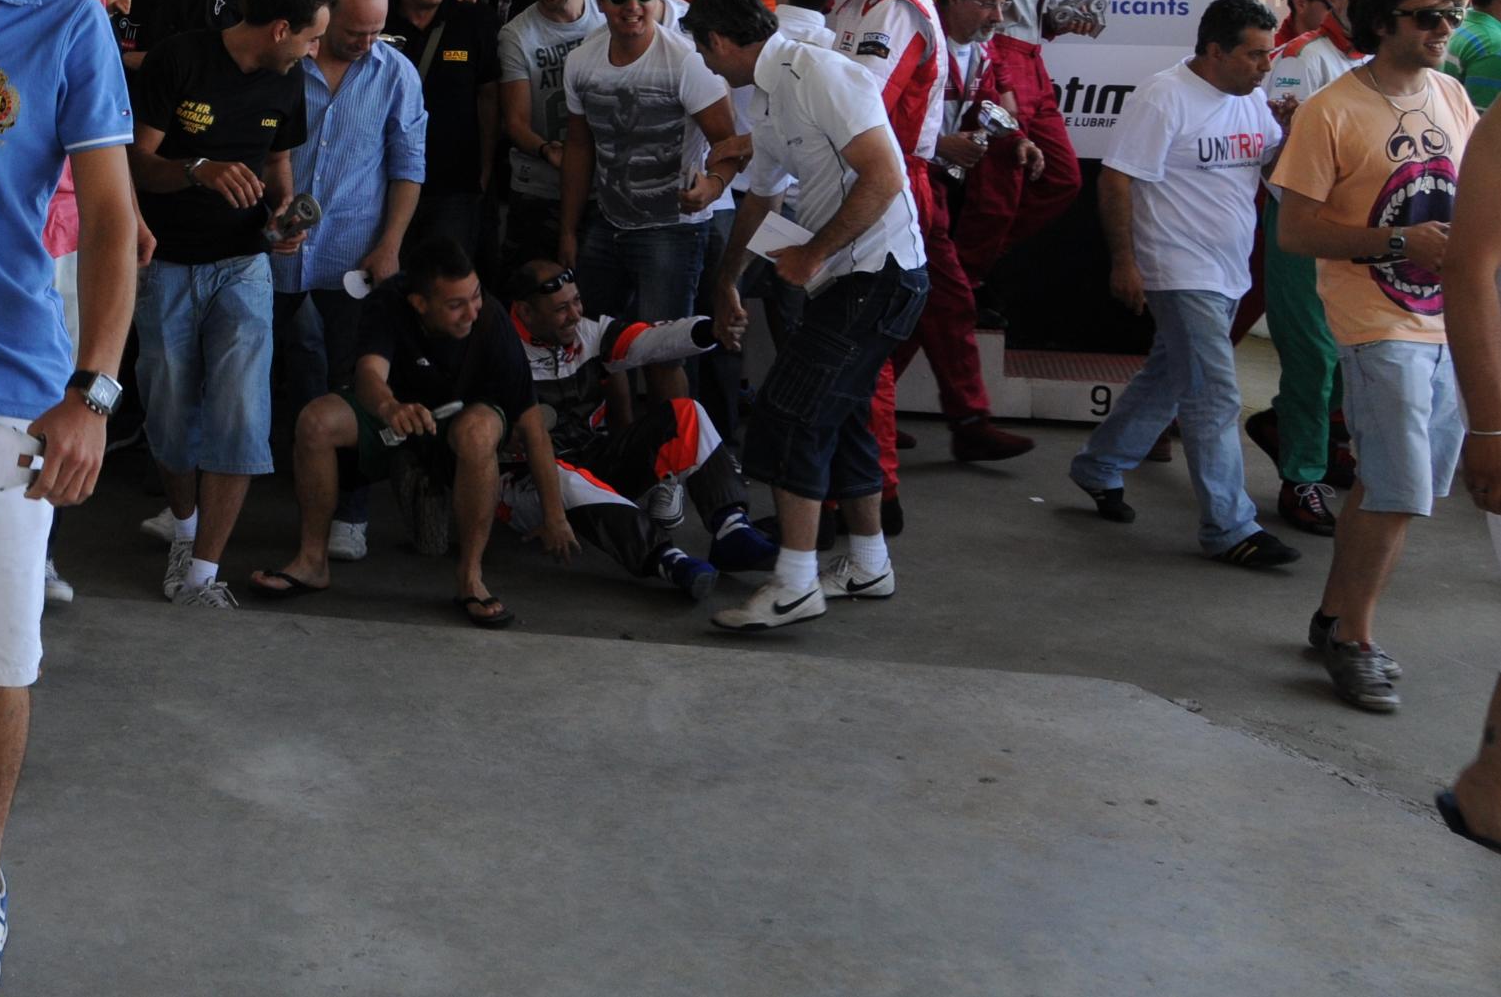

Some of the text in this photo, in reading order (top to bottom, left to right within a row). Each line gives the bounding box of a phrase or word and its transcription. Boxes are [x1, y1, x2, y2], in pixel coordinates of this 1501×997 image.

[1065, 117, 1117, 128] E LUBRIF
[1089, 383, 1112, 417] 9
